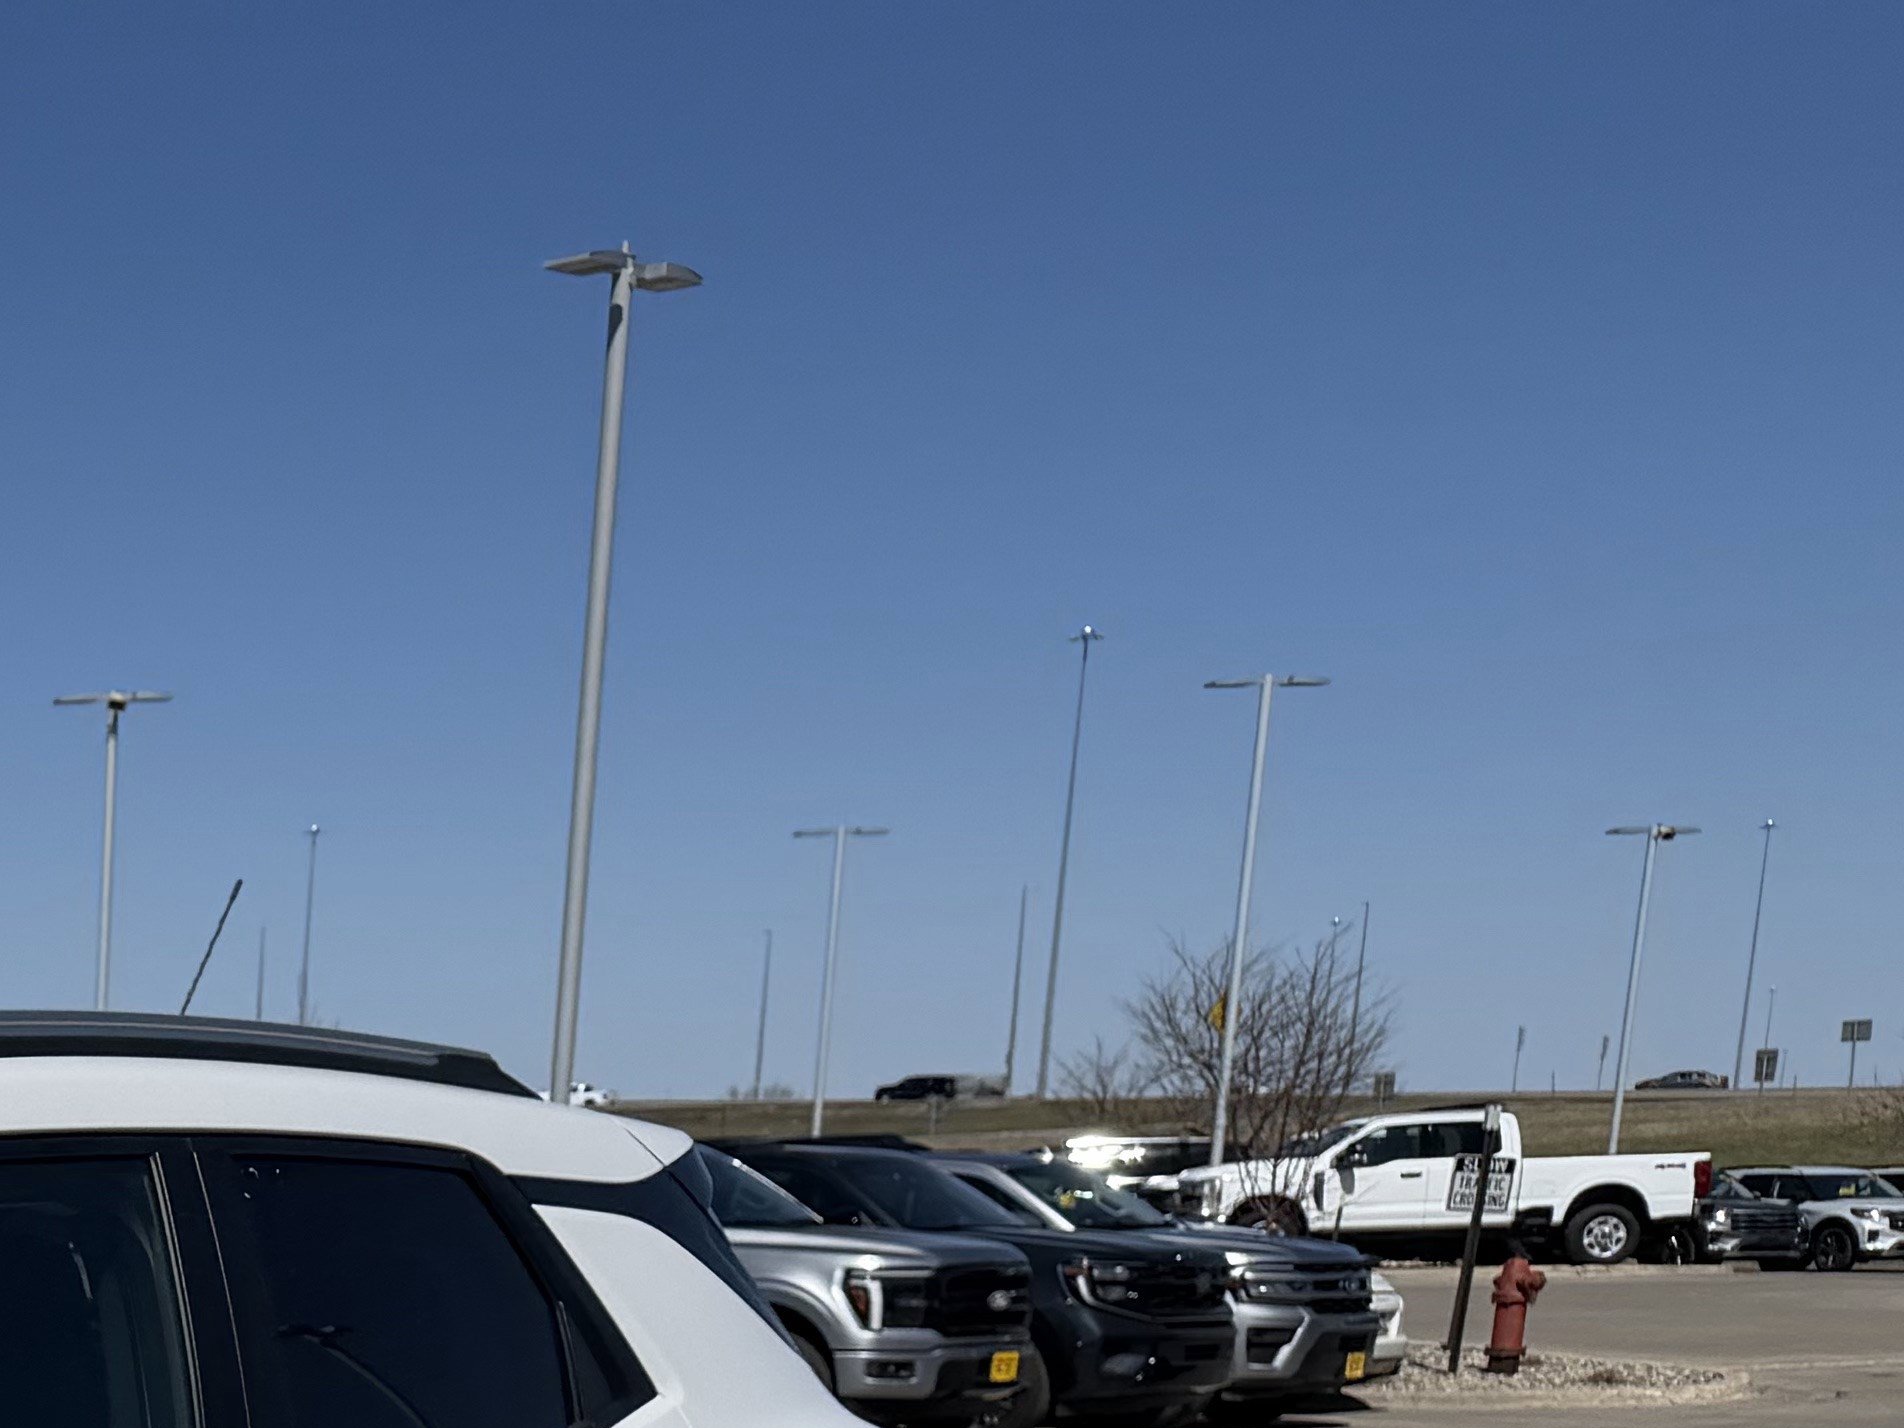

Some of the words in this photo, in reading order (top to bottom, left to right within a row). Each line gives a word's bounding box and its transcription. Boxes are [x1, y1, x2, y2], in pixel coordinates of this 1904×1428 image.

[1463, 1155, 1509, 1174] SLW
[1459, 1175, 1506, 1191] TRAFIC
[1452, 1191, 1505, 1207] CROING
